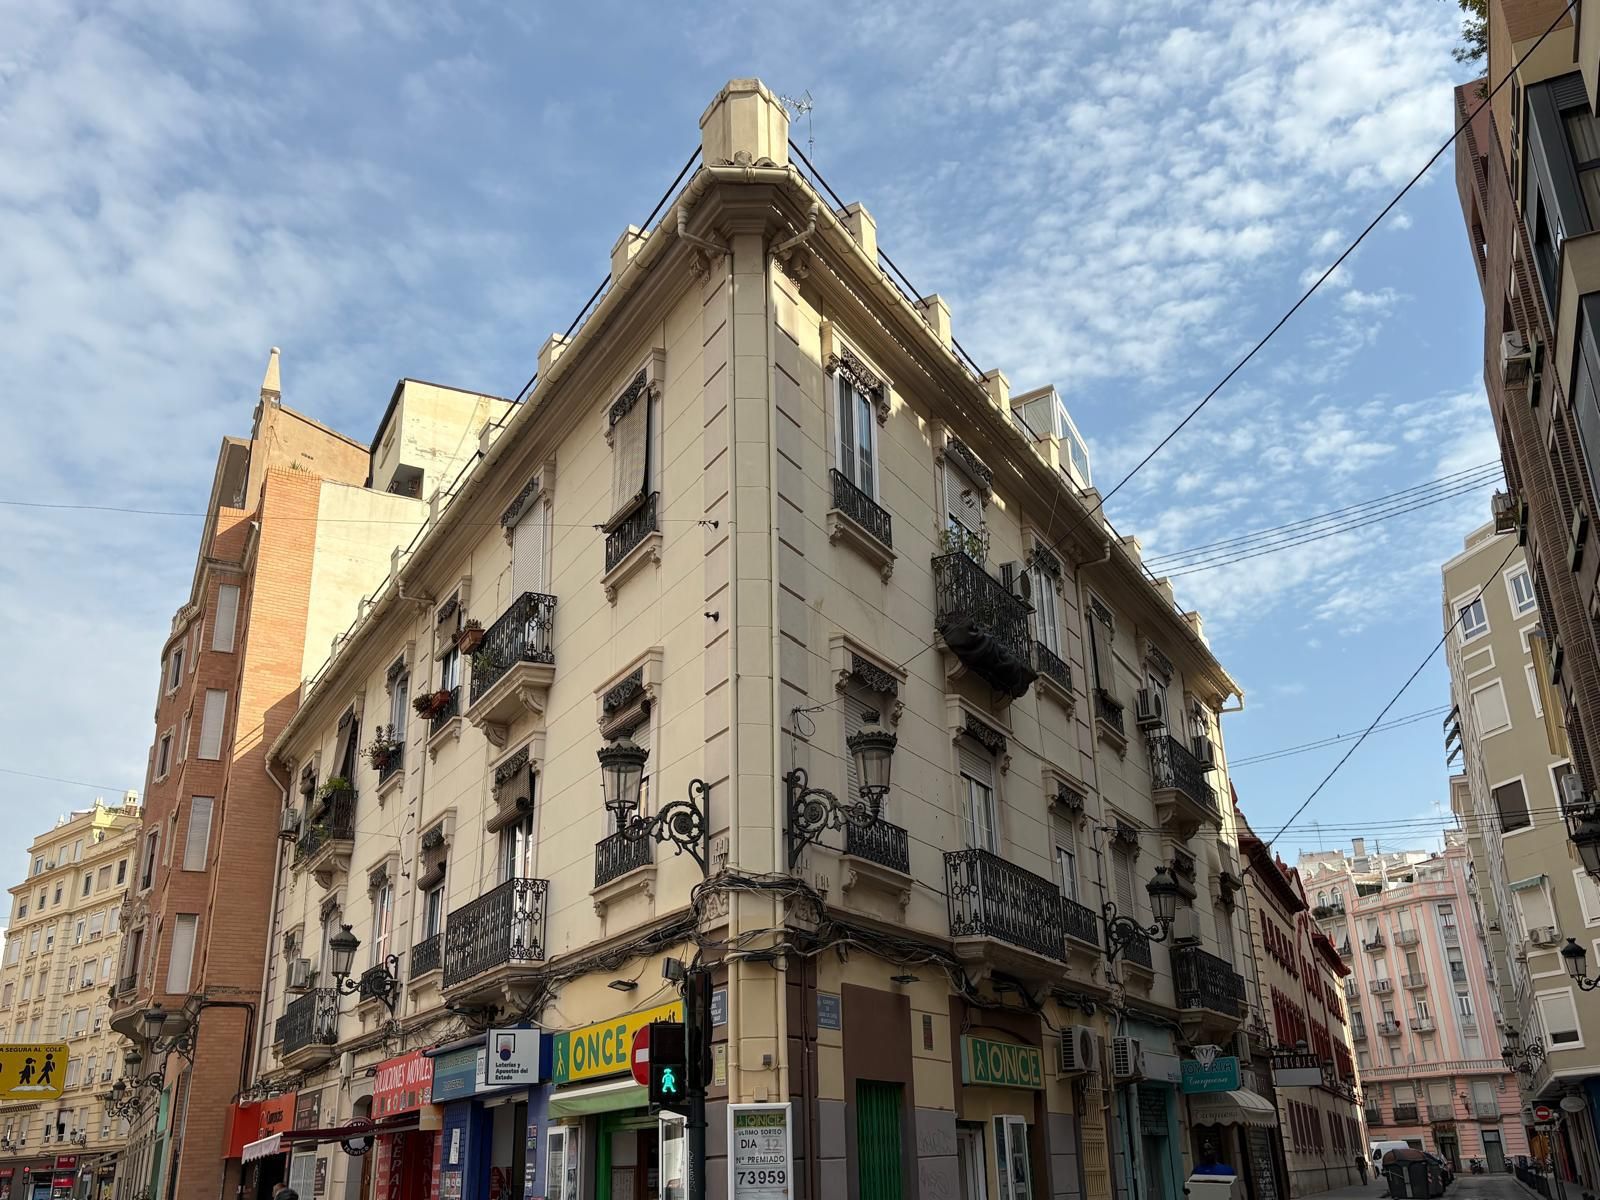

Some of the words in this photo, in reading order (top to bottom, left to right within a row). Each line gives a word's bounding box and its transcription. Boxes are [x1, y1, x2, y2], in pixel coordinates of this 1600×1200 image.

[573, 1024, 626, 1071] ONCE
[990, 1045, 1040, 1083] ONCE
[374, 1063, 404, 1094] SOLUCIONES
[747, 1114, 785, 1126] ONCE
[741, 1139, 757, 1149] DIA
[748, 1155, 785, 1163] PREMIADO
[738, 1170, 785, 1185] 73959
